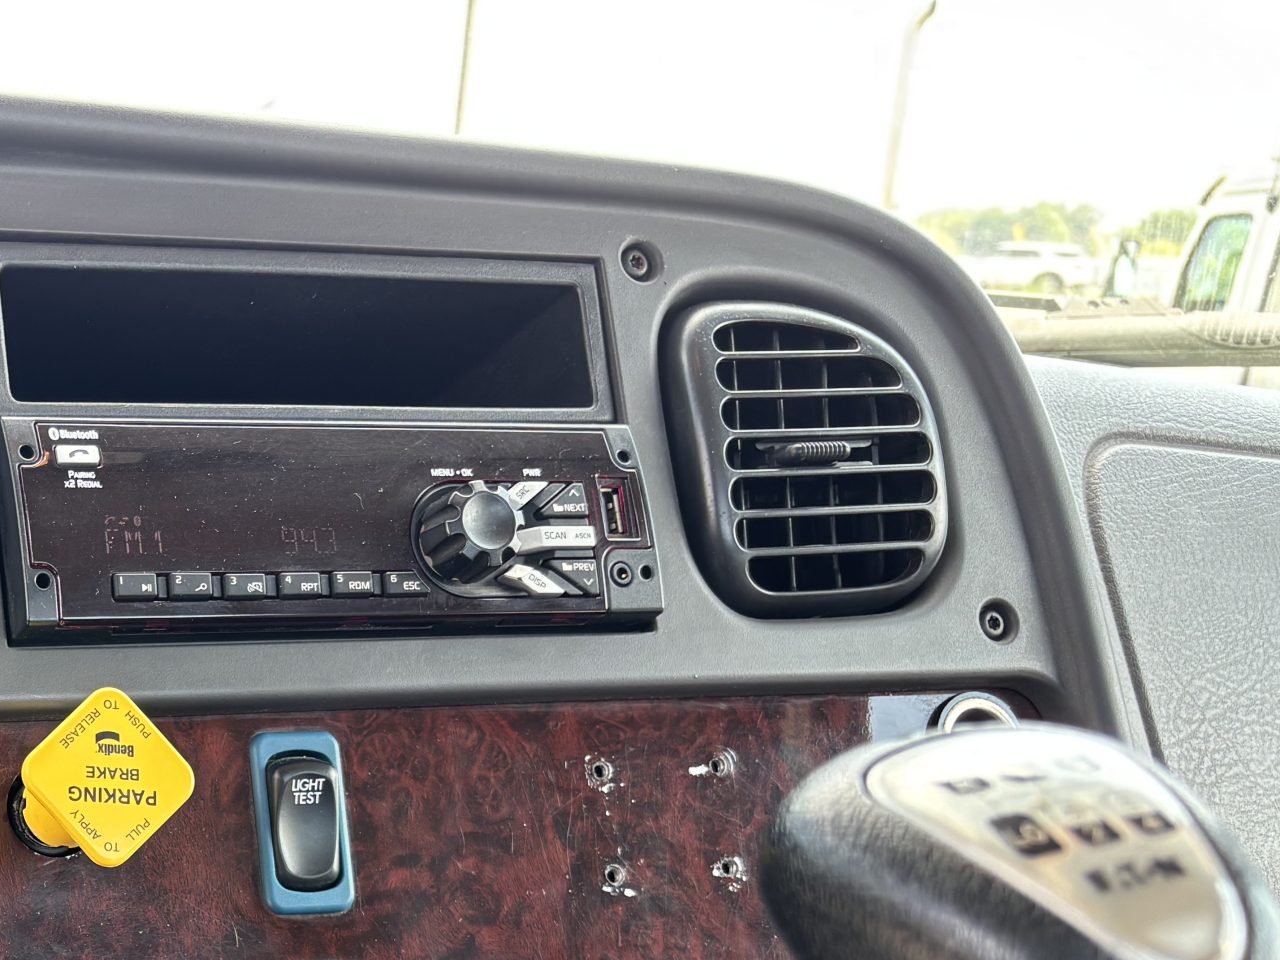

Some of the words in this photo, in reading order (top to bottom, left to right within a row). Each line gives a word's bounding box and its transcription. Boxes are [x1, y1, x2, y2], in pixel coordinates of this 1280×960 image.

[59, 429, 99, 439] Bluetooth
[431, 468, 454, 477] MENU
[523, 468, 542, 477] PWR
[516, 485, 530, 499] SRC
[564, 504, 585, 512] NEXT
[544, 531, 567, 540] SCAN
[573, 563, 594, 571] PREV
[285, 575, 292, 584] 4
[336, 574, 343, 583] 5
[390, 574, 398, 583] 6
[528, 573, 546, 589] DISP
[301, 582, 318, 592] RPT
[349, 581, 370, 590] RDM
[403, 581, 420, 590] ESC
[103, 699, 119, 710] TO
[59, 708, 101, 749] RELEASE
[124, 710, 151, 739] PUSH
[97, 743, 134, 757] Bendix
[86, 765, 139, 781] BRAKE
[292, 778, 325, 791] LIGHT
[68, 785, 157, 806] PARKING
[293, 791, 322, 805] TEST
[70, 809, 102, 840] APPLY
[126, 818, 151, 841] PULL
[104, 842, 120, 852] TO
